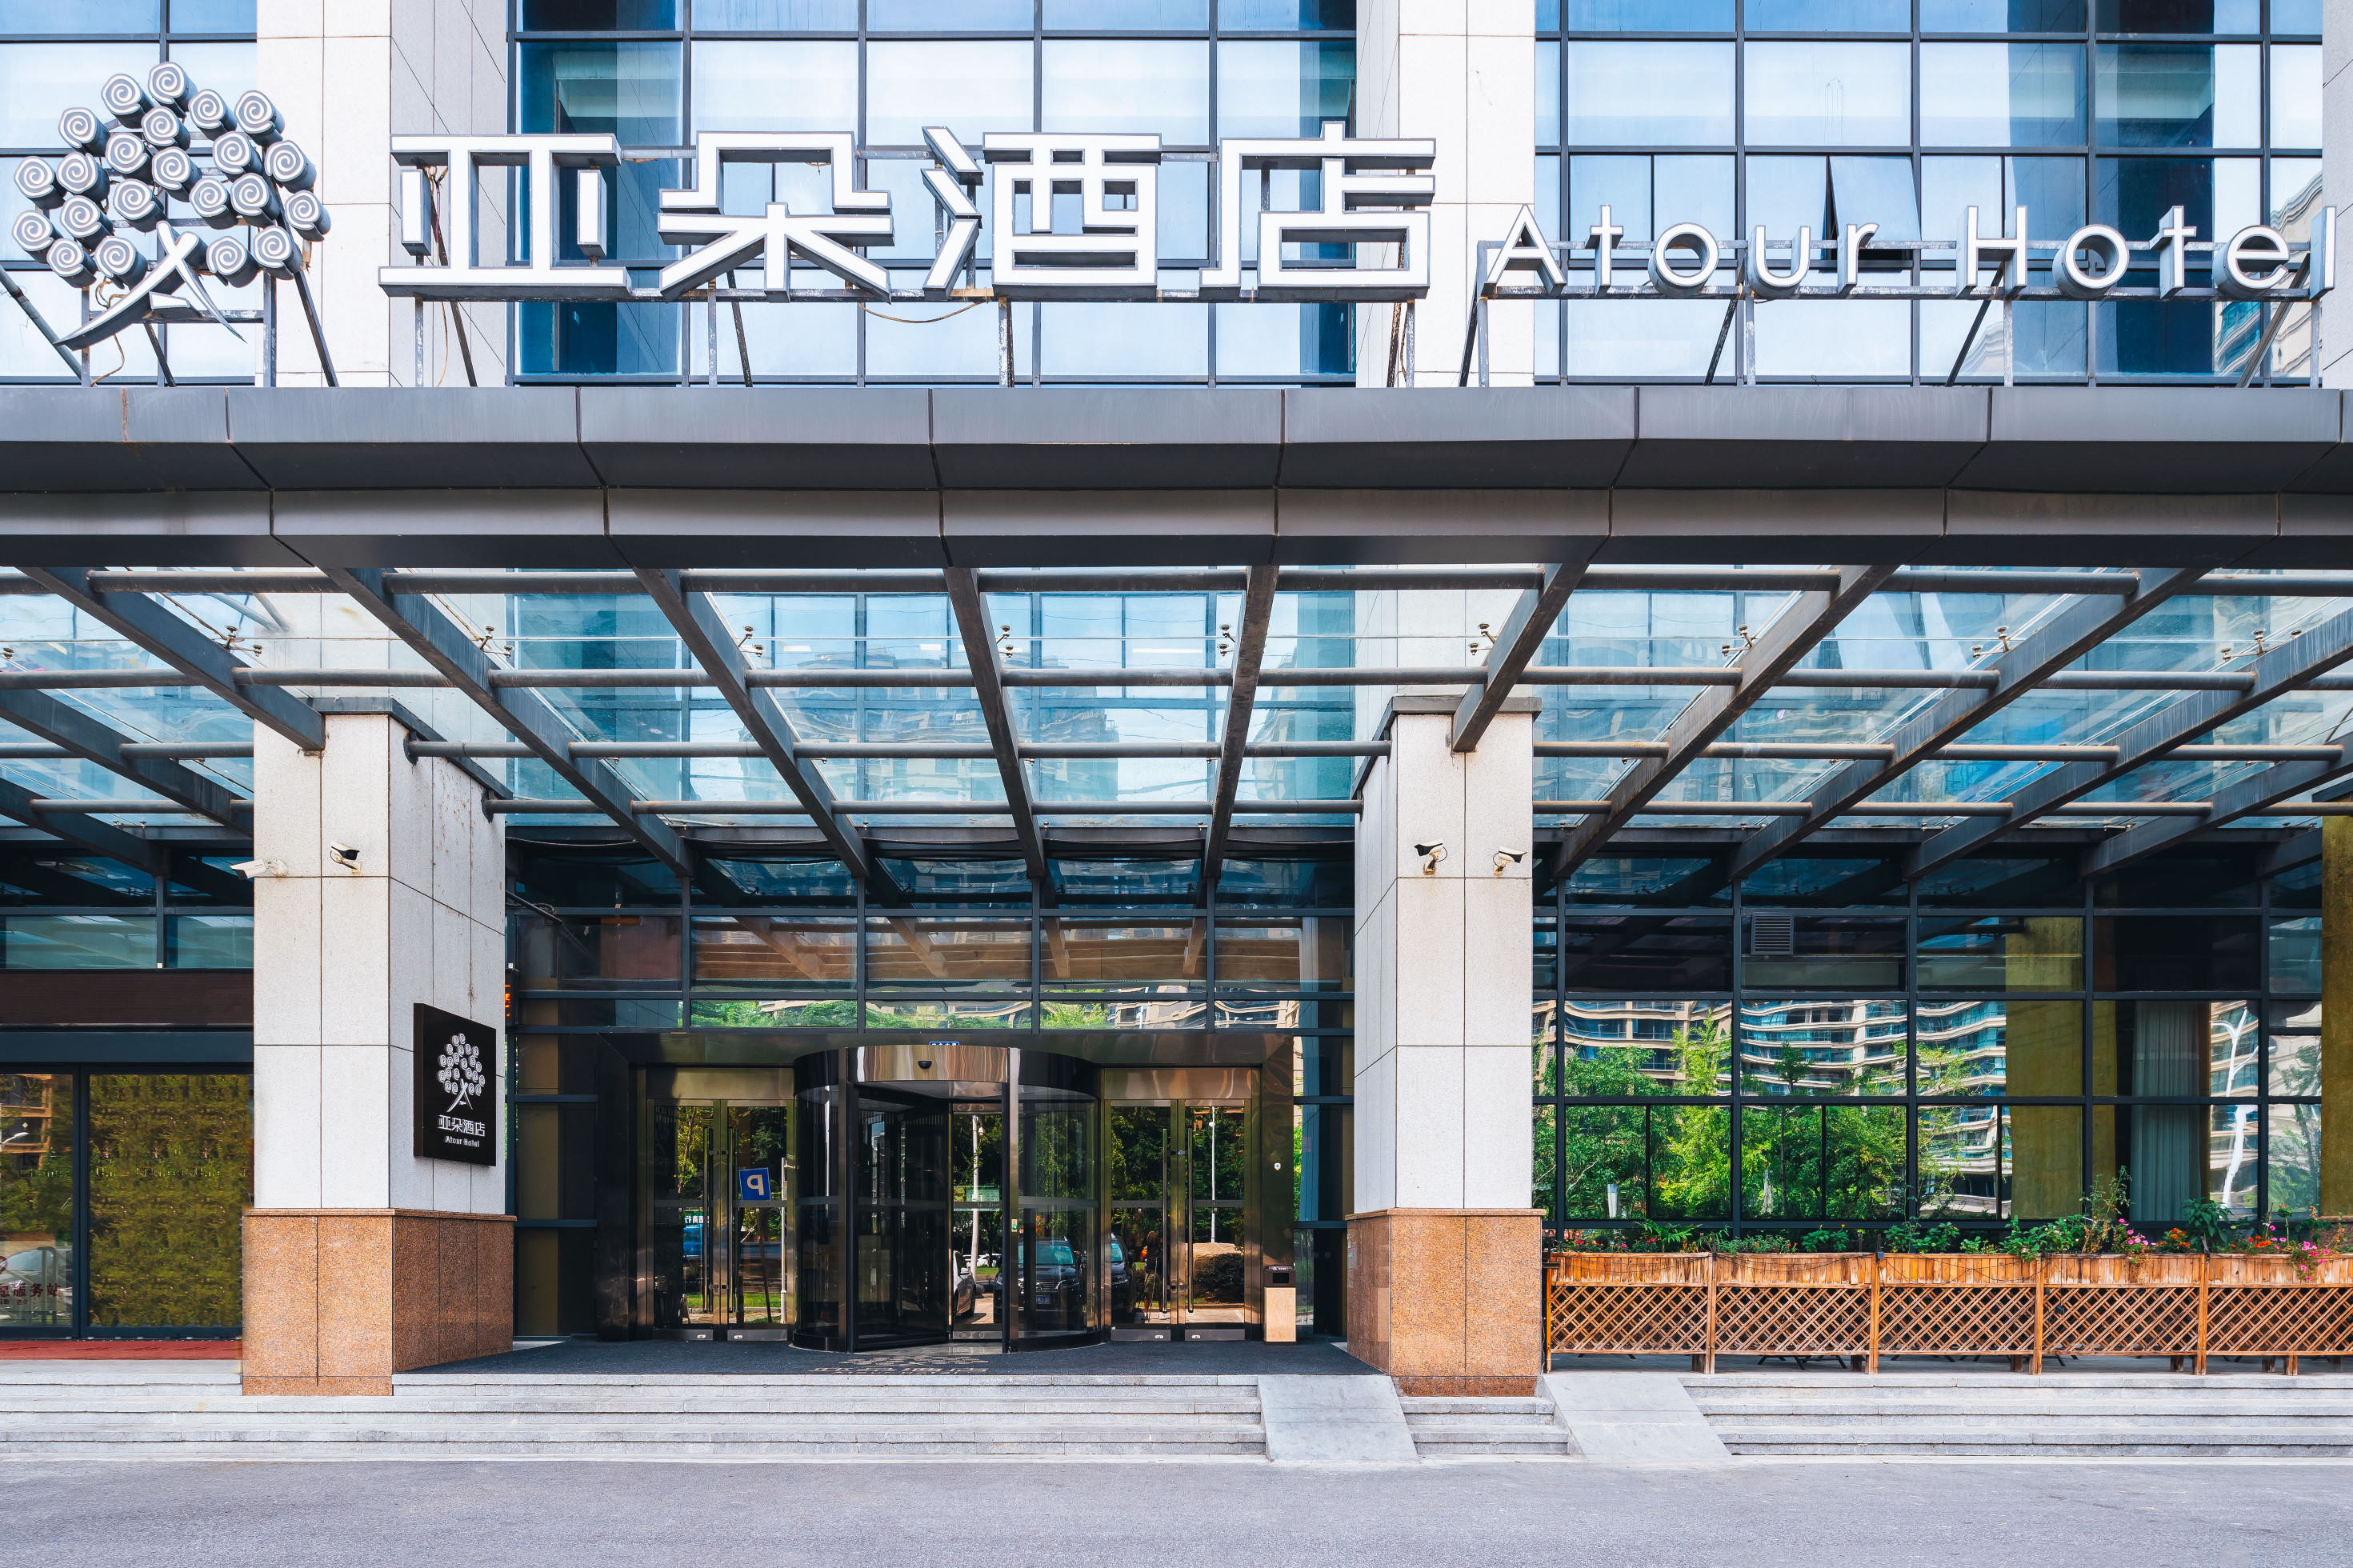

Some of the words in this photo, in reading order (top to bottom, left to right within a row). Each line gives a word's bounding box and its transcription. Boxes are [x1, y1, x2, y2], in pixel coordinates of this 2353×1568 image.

[379, 121, 1436, 303] 亚朵酒店
[1487, 204, 1879, 297] Atour
[1957, 205, 2337, 298] Hotel
[438, 1114, 485, 1136] 亚朵酒店
[445, 1135, 462, 1144] Atour
[464, 1138, 479, 1147] Hotel
